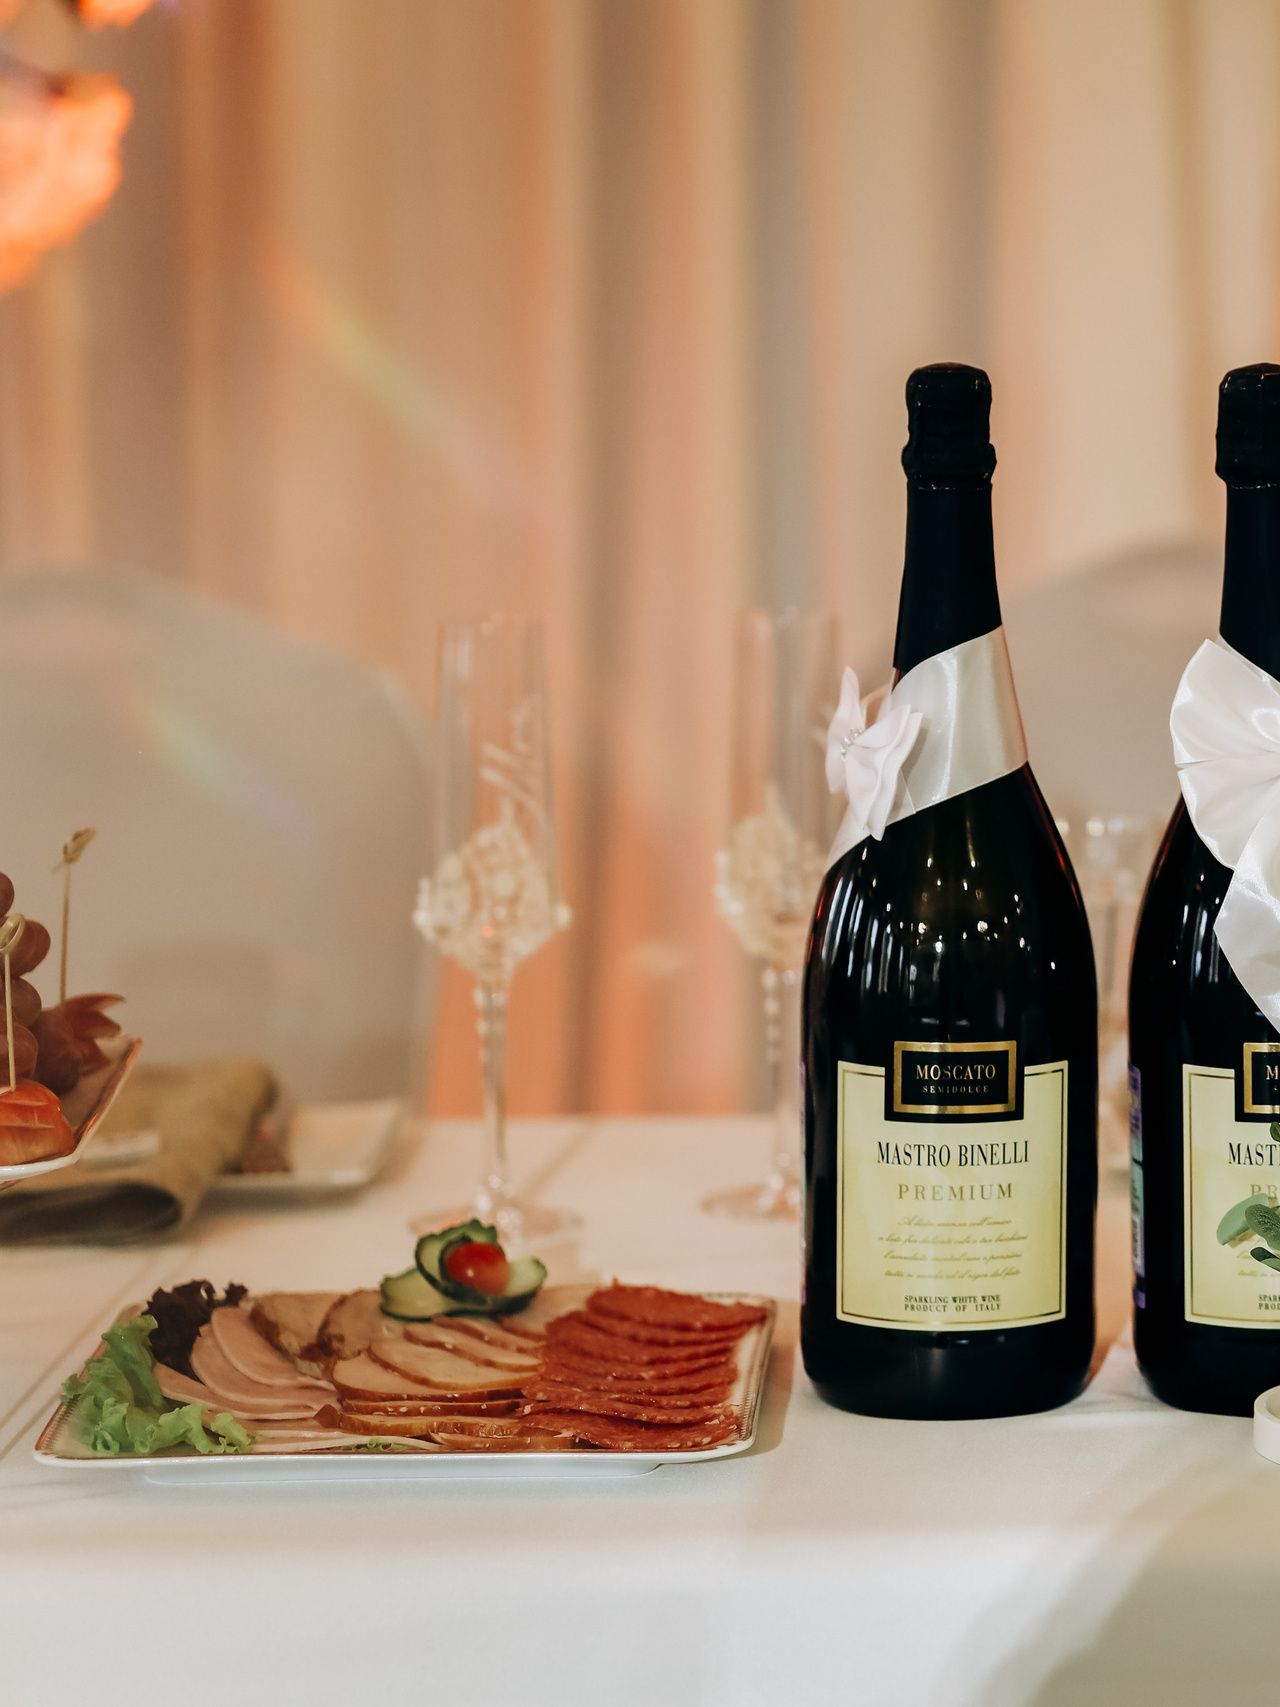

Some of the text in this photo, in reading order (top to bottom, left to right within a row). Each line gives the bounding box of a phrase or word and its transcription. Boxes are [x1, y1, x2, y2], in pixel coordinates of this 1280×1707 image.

[916, 1064, 996, 1080] MOSCATO
[922, 1085, 989, 1094] SEMIDOLCE
[877, 1140, 1029, 1167] MASTRO BINELLI
[897, 1183, 1013, 1201] PREMIUM
[904, 1294, 1000, 1304] SPARKLING WHITE WINE
[904, 1303, 1001, 1312] PRODUCT OF ITALY
